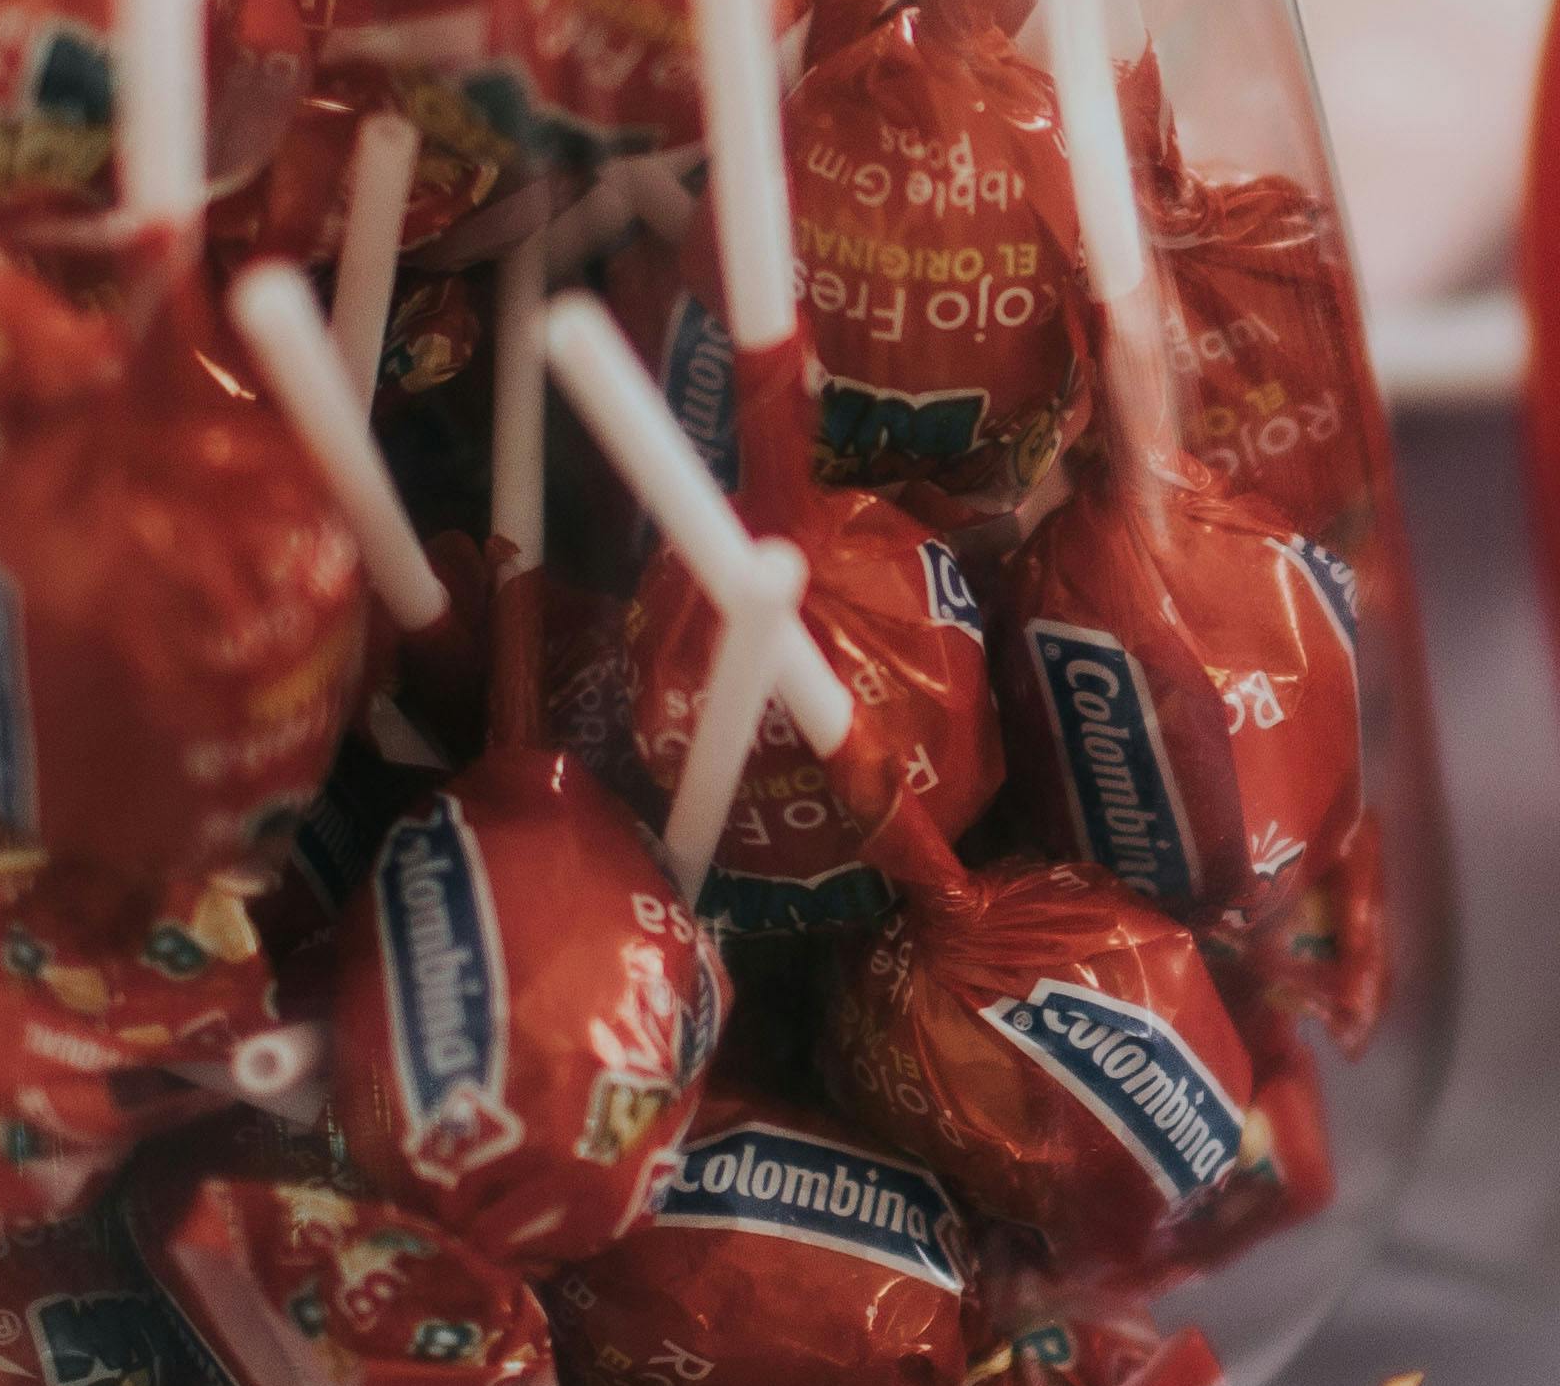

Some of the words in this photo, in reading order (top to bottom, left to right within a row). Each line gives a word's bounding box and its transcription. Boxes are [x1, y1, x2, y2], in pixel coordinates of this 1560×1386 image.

[995, 242, 1039, 278] EL
[792, 256, 906, 343] Fres
[920, 273, 1058, 343] ojo
[397, 834, 483, 1075] olombina
